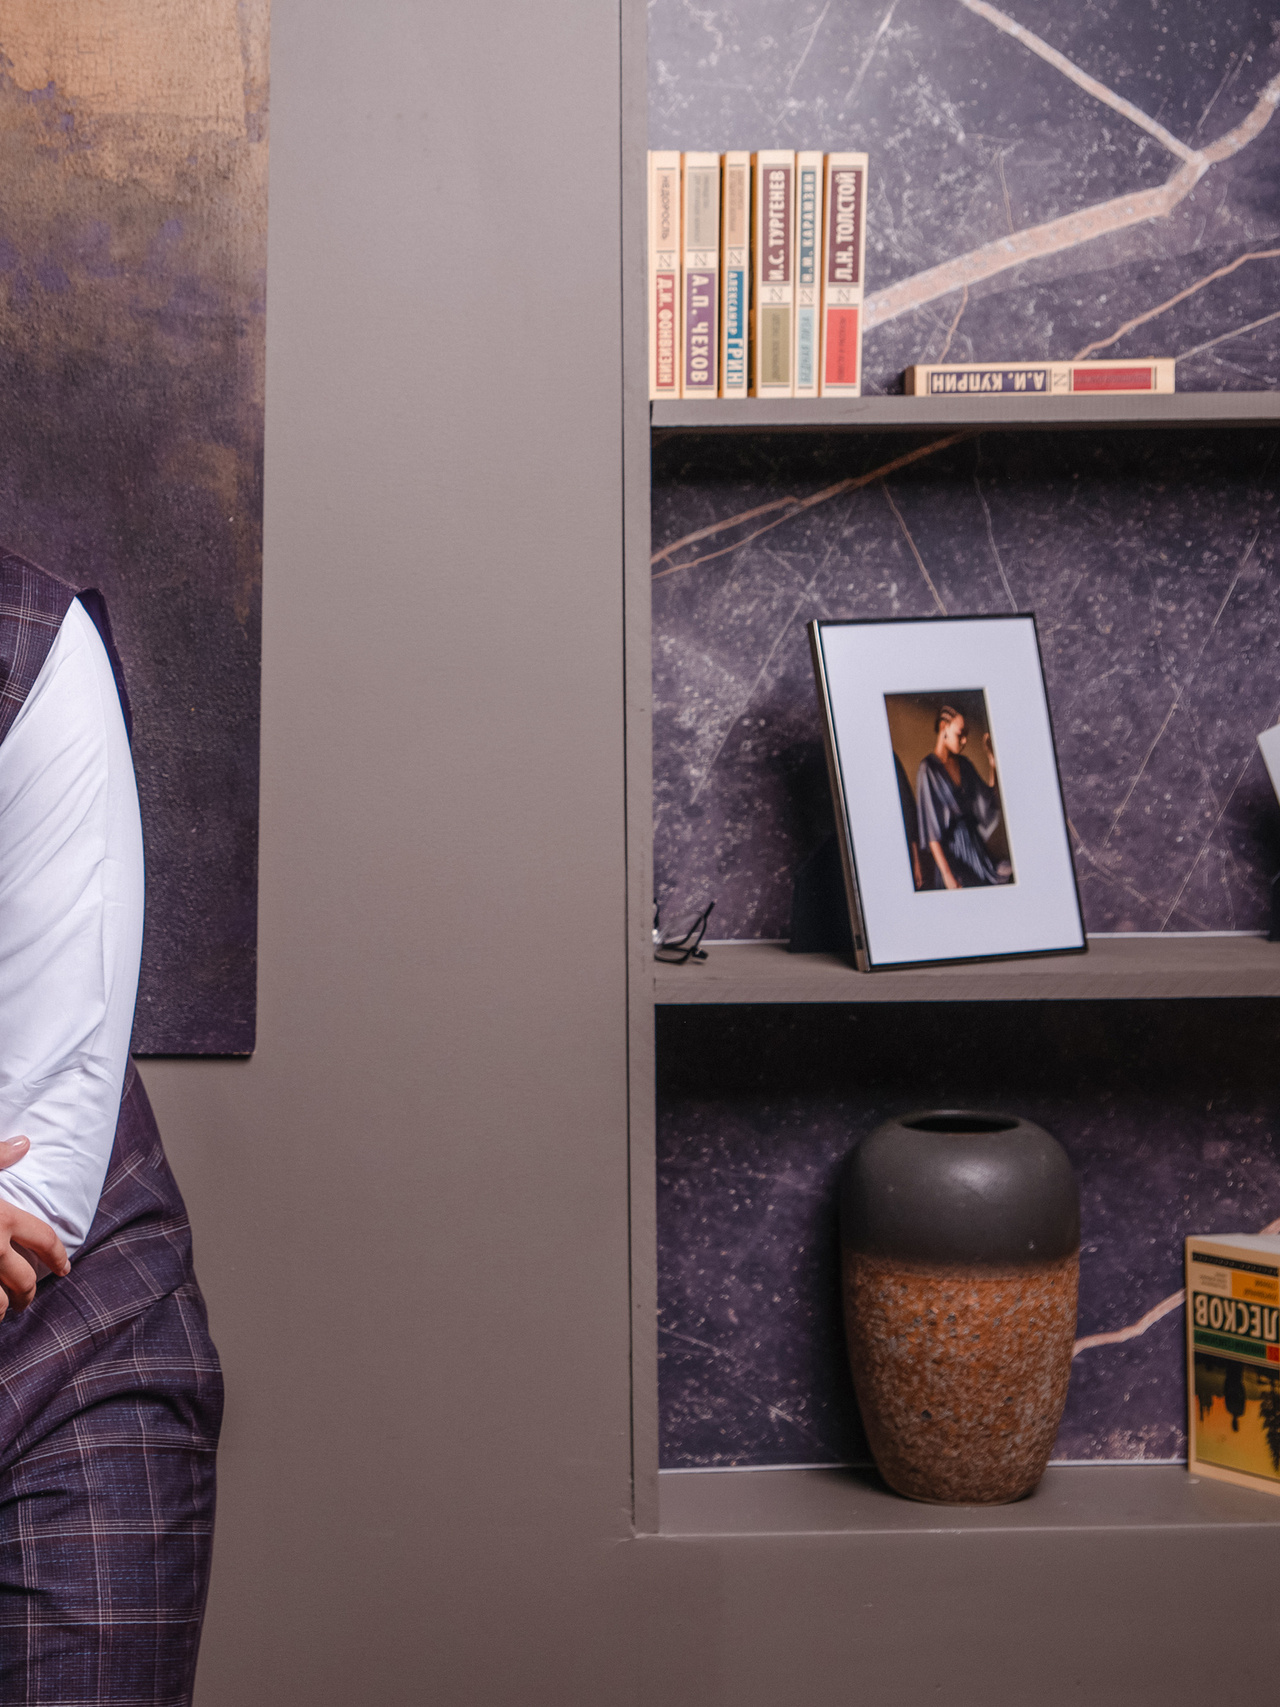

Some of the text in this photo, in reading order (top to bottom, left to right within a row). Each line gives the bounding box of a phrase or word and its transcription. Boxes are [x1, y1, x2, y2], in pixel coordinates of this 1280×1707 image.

[768, 170, 785, 281] И.С. ТУРГЕНЕВ
[802, 173, 815, 247] КАРАМЗИН
[834, 171, 856, 281] Л.Н. ТОЛСТОЙ
[657, 278, 673, 384] Д.И. ФОНВИЗИН
[690, 274, 710, 383] А.П. ЧЕХОВ
[726, 271, 744, 384] АЛЕКСАНДР ГРИН
[932, 372, 1045, 392] А.И. КУПРИН
[1195, 1294, 1279, 1341] ЛЕСКОВ
